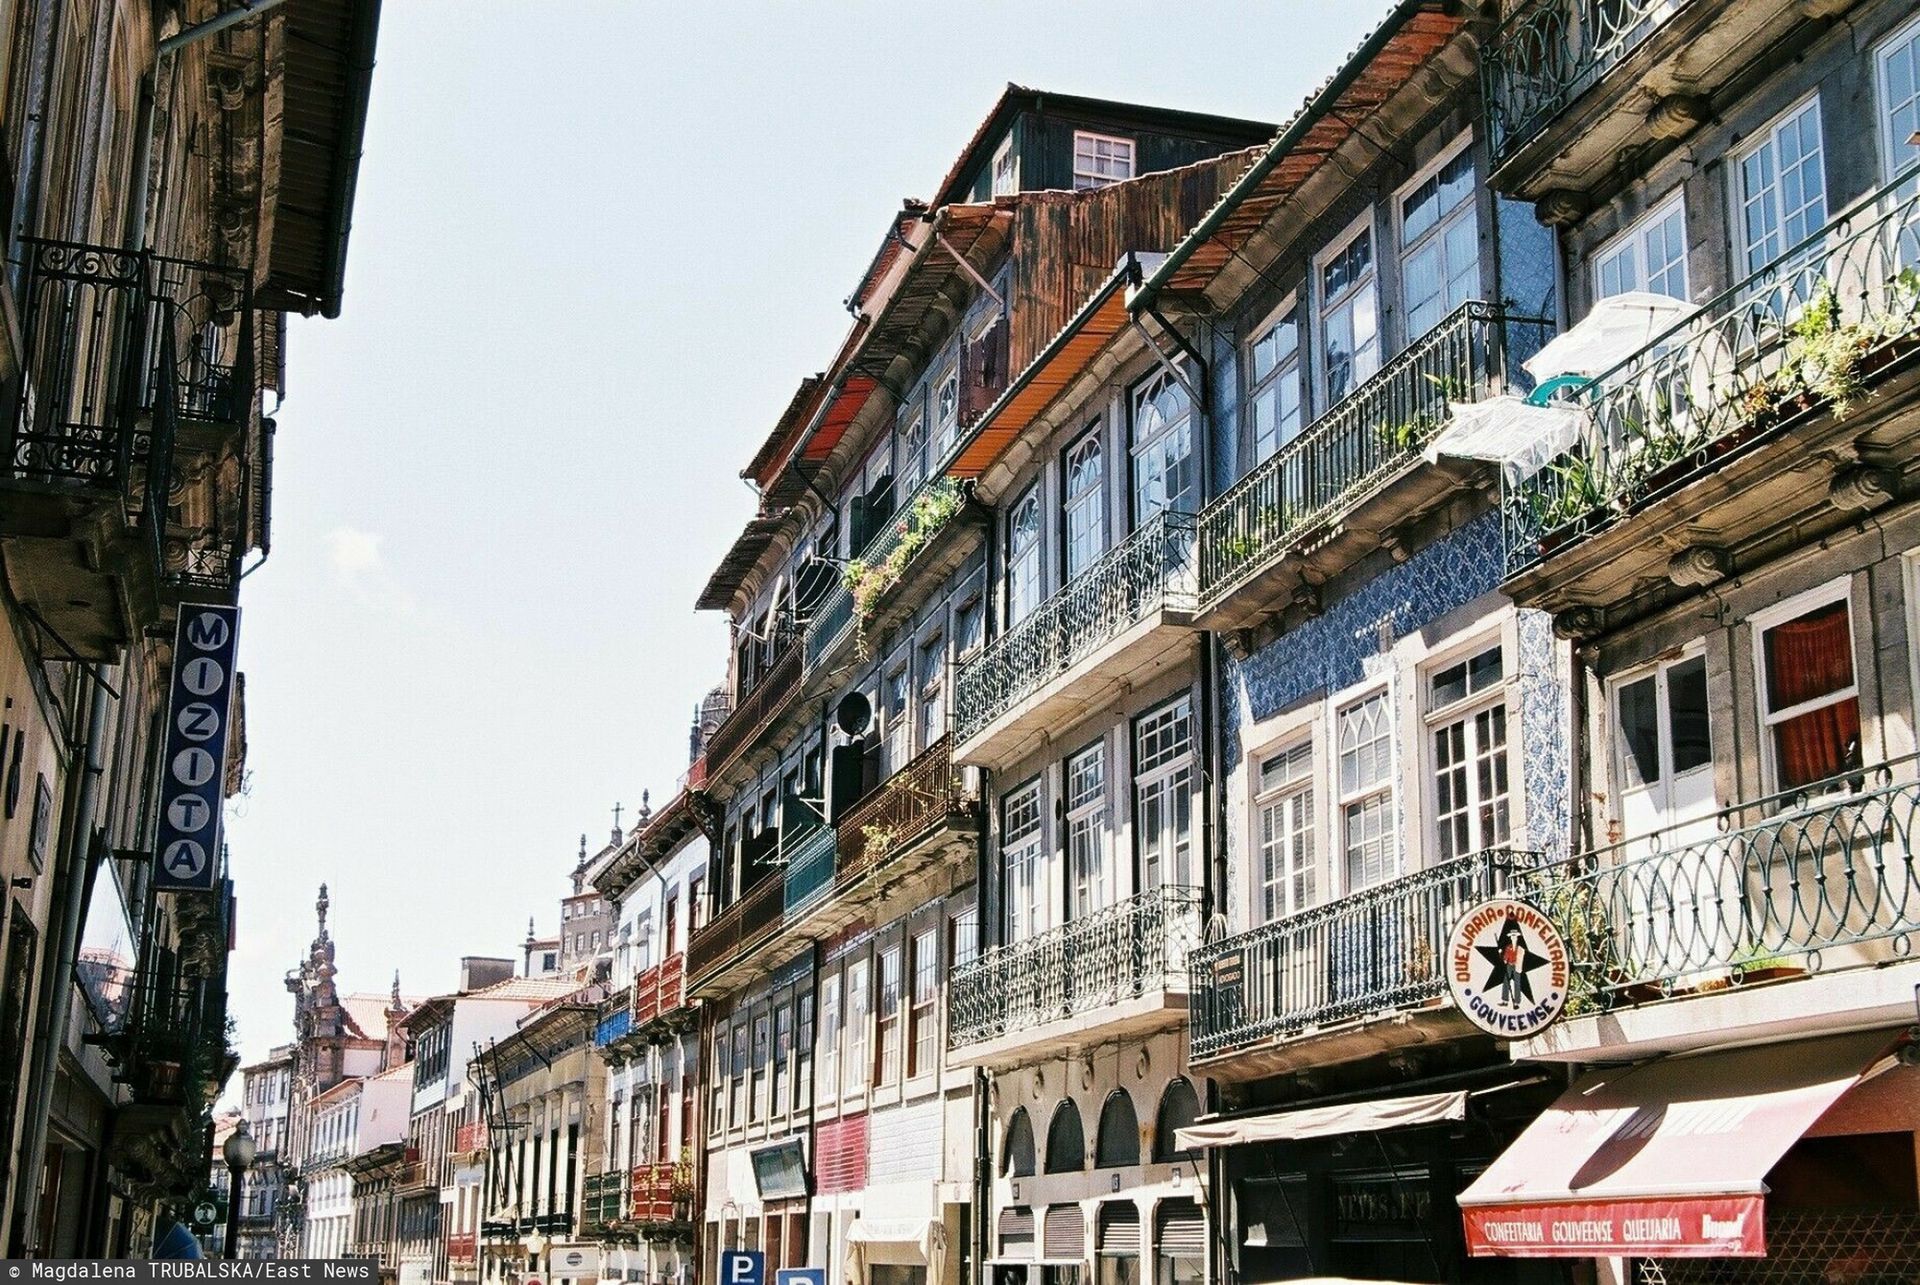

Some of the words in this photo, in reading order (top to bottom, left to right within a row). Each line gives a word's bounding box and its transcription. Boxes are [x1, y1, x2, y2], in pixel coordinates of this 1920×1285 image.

[168, 614, 224, 874] MIZITA
[1454, 906, 1498, 983] QUEIJARIA
[1504, 904, 1566, 988] CONFEITARIA
[1469, 995, 1555, 1032] GOUVEENSE
[1484, 1221, 1544, 1243] CONFEITARIA
[1552, 1219, 1613, 1243] GOUVEENSE
[1622, 1217, 1682, 1241] QUEIJARIA
[732, 1256, 755, 1283] P
